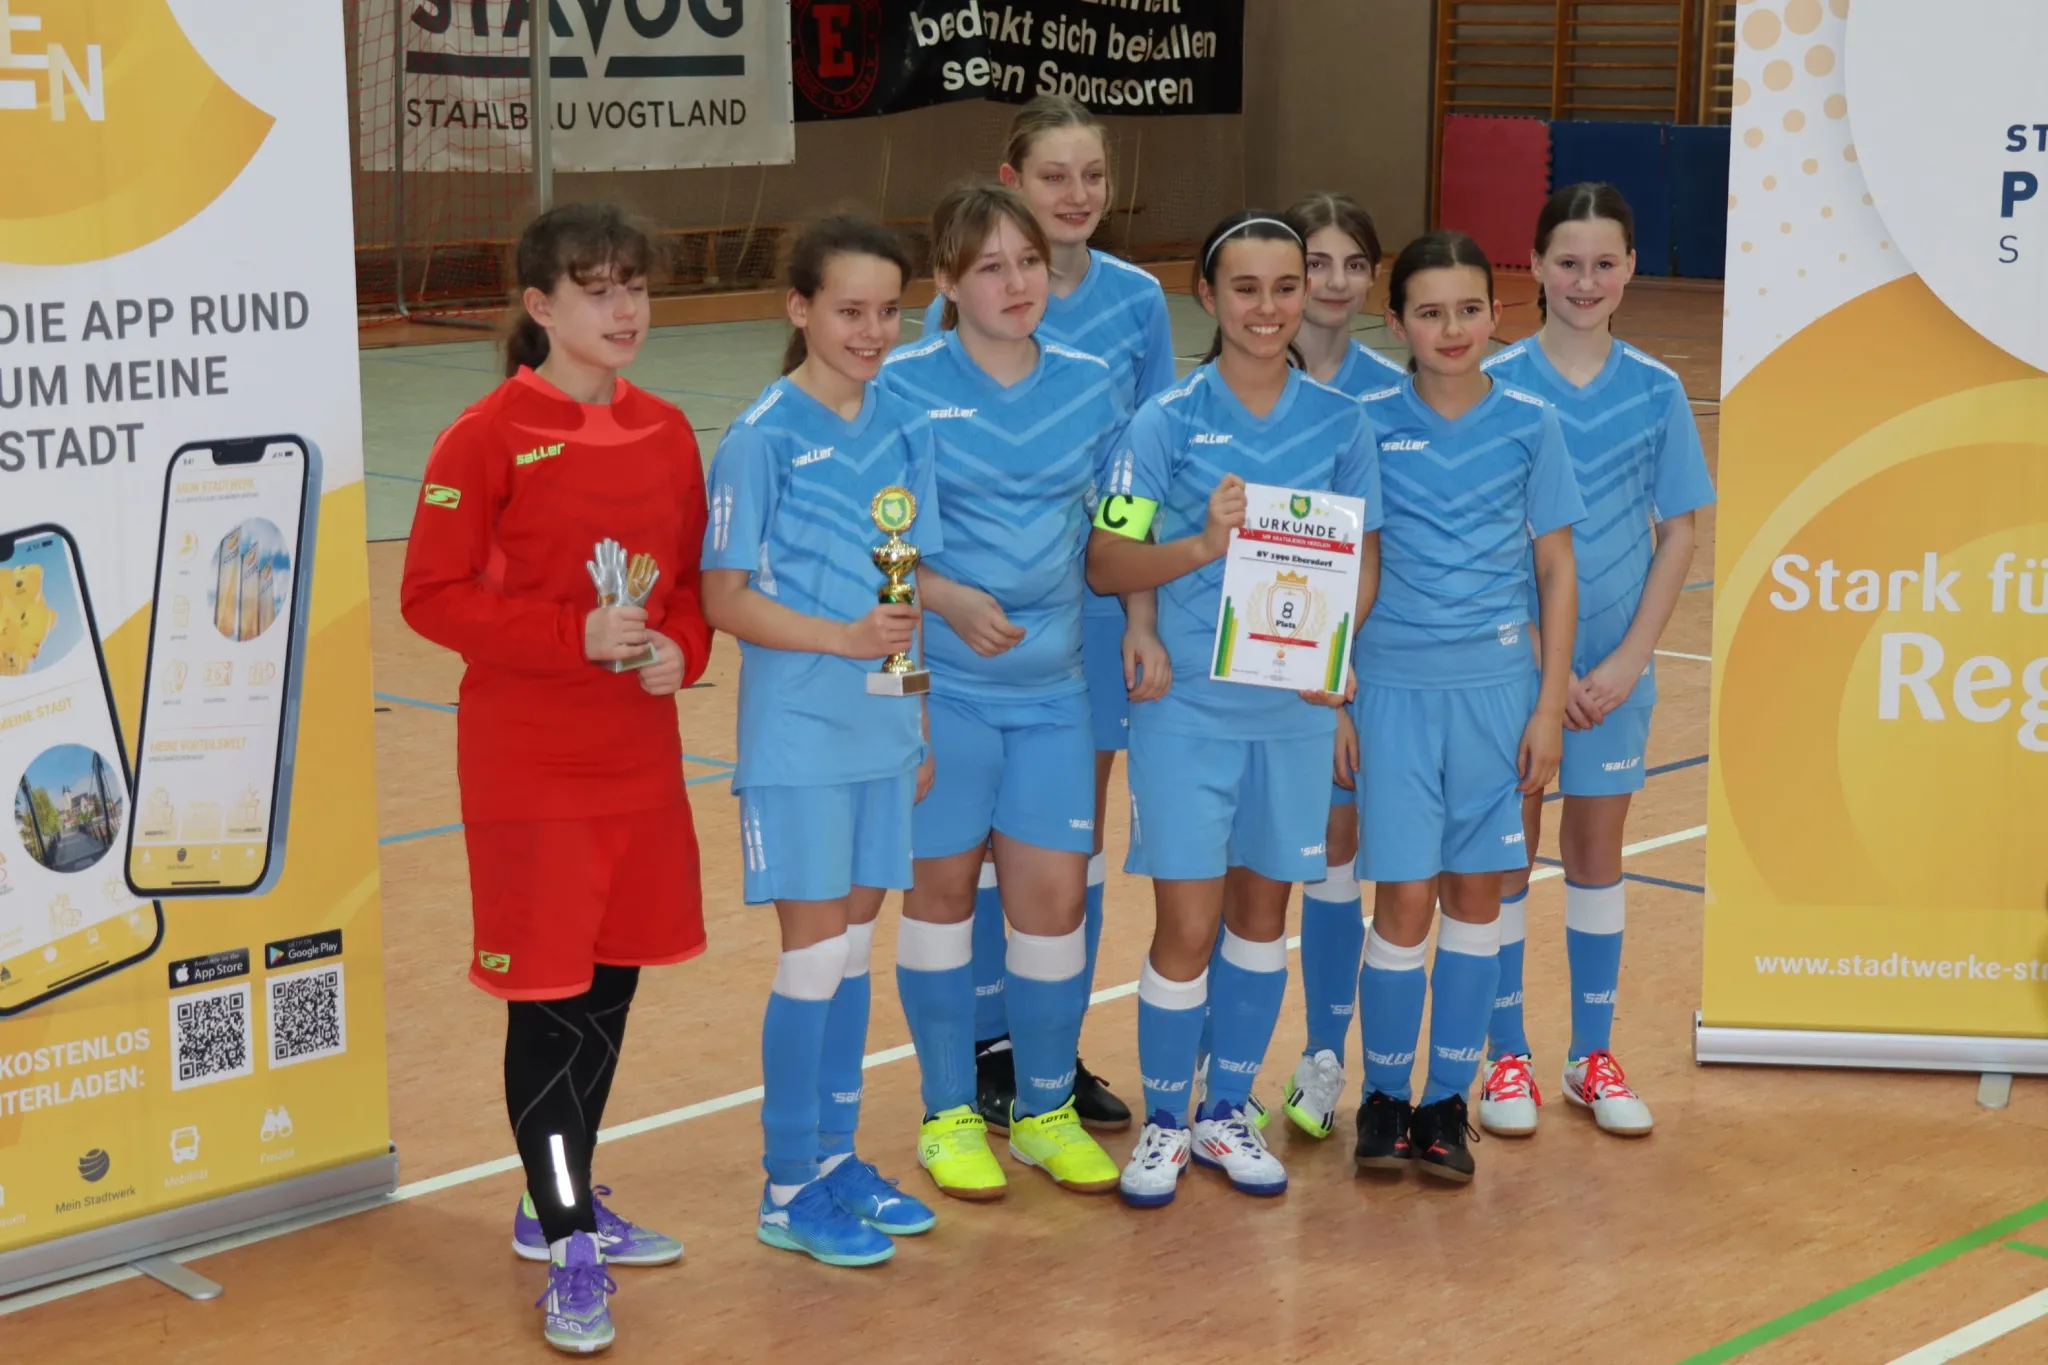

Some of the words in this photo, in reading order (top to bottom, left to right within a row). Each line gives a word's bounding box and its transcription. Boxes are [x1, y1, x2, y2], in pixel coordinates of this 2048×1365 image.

[1041, 14, 1097, 55] sich
[1036, 60, 1194, 106] Sponsoren
[407, 99, 576, 130] STAHLBU
[587, 99, 746, 130] VOGTLAND
[2000, 171, 2039, 218] P
[1998, 235, 2019, 263] S
[0, 302, 66, 345] DIE
[82, 297, 175, 342] APP
[190, 290, 310, 337] RUND
[0, 364, 69, 410] UM
[85, 355, 229, 405] MEINE
[0, 422, 144, 473] STADT
[1190, 433, 1233, 444] aller
[516, 443, 565, 466] saller
[1103, 494, 1134, 528] C
[1259, 517, 1337, 539] URKUNDE
[1257, 550, 1269, 558] SV
[1769, 552, 1961, 612] Stark
[1987, 552, 2048, 614] fü
[1276, 620, 1297, 629] Platz
[1282, 601, 1294, 619] 8
[1877, 631, 2048, 752] Reg
[36, 697, 73, 718] STADT
[288, 945, 319, 958] Google
[321, 941, 338, 953] Play
[194, 967, 215, 981] App
[217, 962, 243, 976] Store
[0, 1027, 150, 1080] KOSTENLOS
[0, 1065, 145, 1117] TERLADEN:
[1041, 1113, 1069, 1124] LOTTO
[55, 1197, 81, 1214] Mein
[84, 1185, 136, 1207] Stadtwerk
